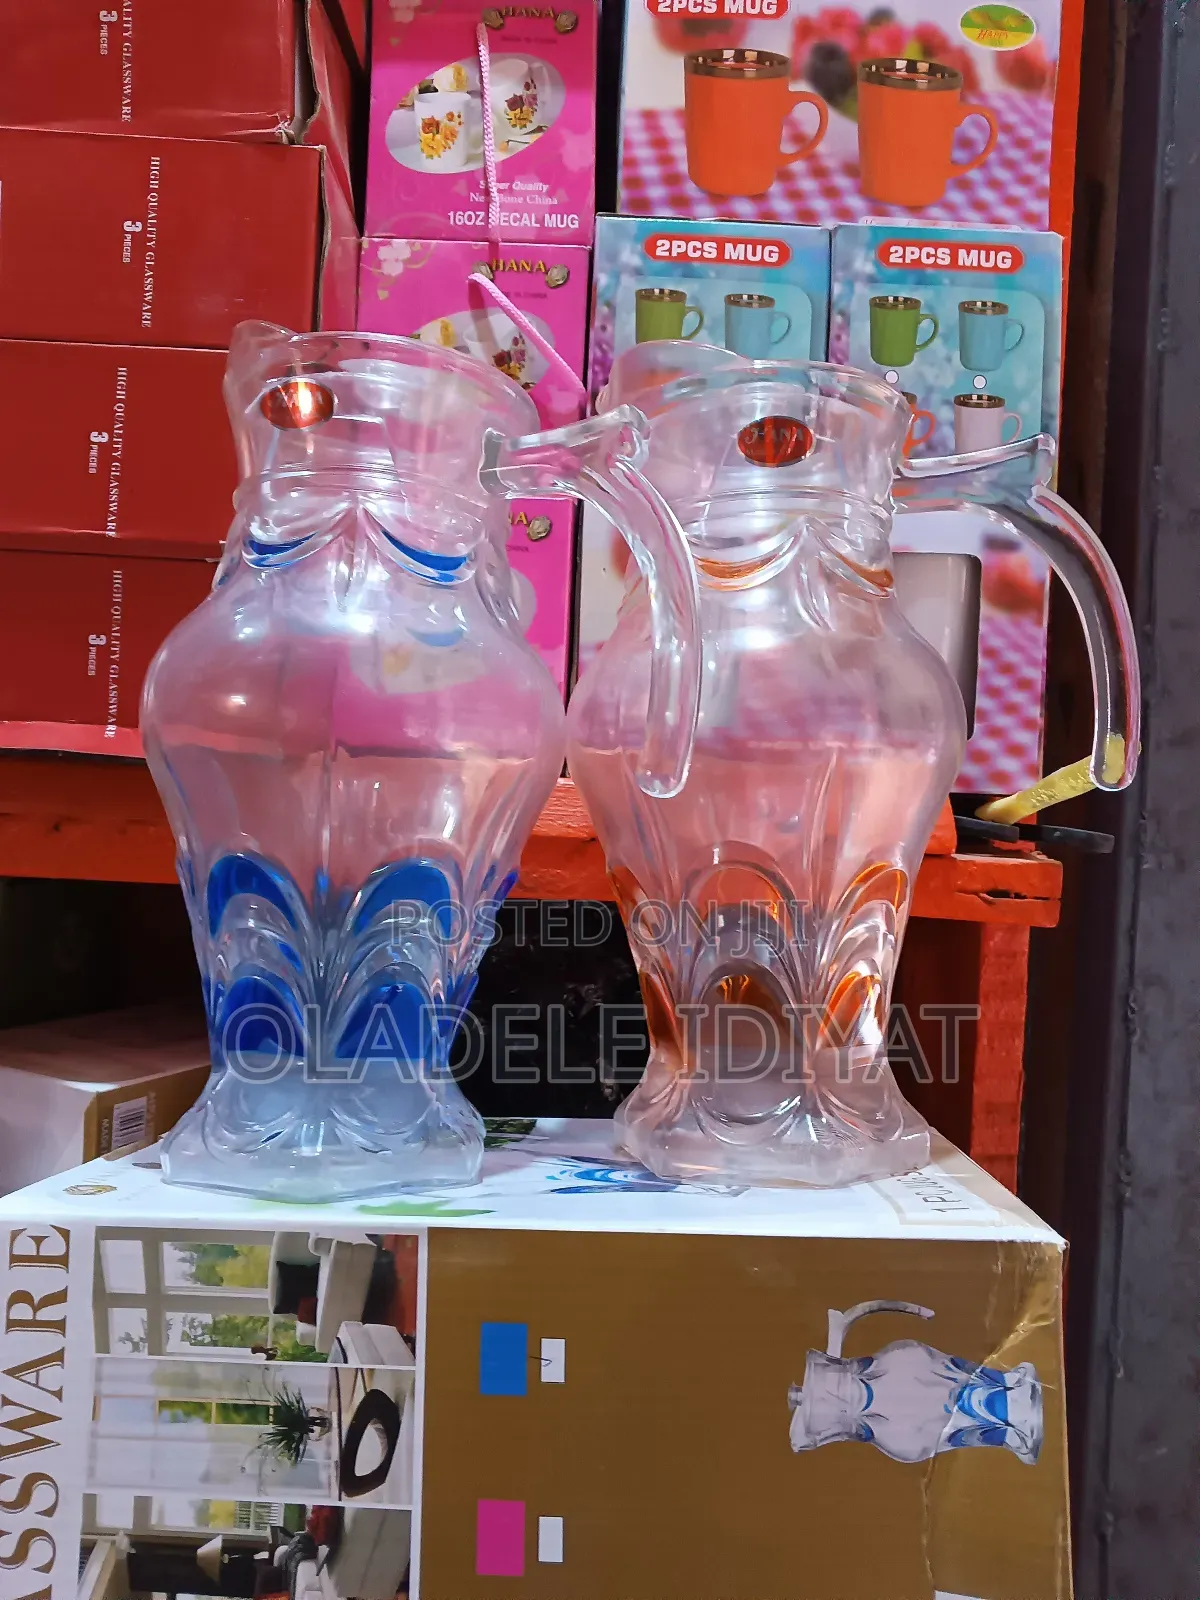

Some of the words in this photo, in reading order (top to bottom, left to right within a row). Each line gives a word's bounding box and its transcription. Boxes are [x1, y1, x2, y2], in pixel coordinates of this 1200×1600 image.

[99, 10, 118, 22] 3
[657, 0, 717, 14] 2PCS
[723, 0, 777, 15] MUG
[100, 24, 108, 55] PIECES
[121, 43, 132, 122] GLASSWARE
[149, 156, 160, 189] HIGH
[512, 181, 549, 192] Quality
[526, 194, 558, 205] China
[123, 220, 143, 233] 3
[146, 191, 159, 248] QUALITY
[490, 211, 540, 227] ECAL
[544, 213, 579, 228] MUG
[122, 233, 132, 263] PIECES
[655, 239, 717, 259] 2PCS
[724, 242, 780, 263] MUG
[889, 245, 950, 266] 2PCS
[957, 248, 1013, 269] MUG
[492, 257, 547, 272] HANA
[141, 251, 155, 328] GLASSWARE
[115, 367, 127, 400] HIGH
[90, 431, 109, 443] 3
[112, 402, 126, 458] QUALITY
[106, 461, 121, 538] GLASSWARE
[112, 570, 122, 602] HIGH
[88, 634, 107, 646] 3
[110, 605, 121, 662] QUALITY
[104, 664, 120, 738] GLASSWARE
